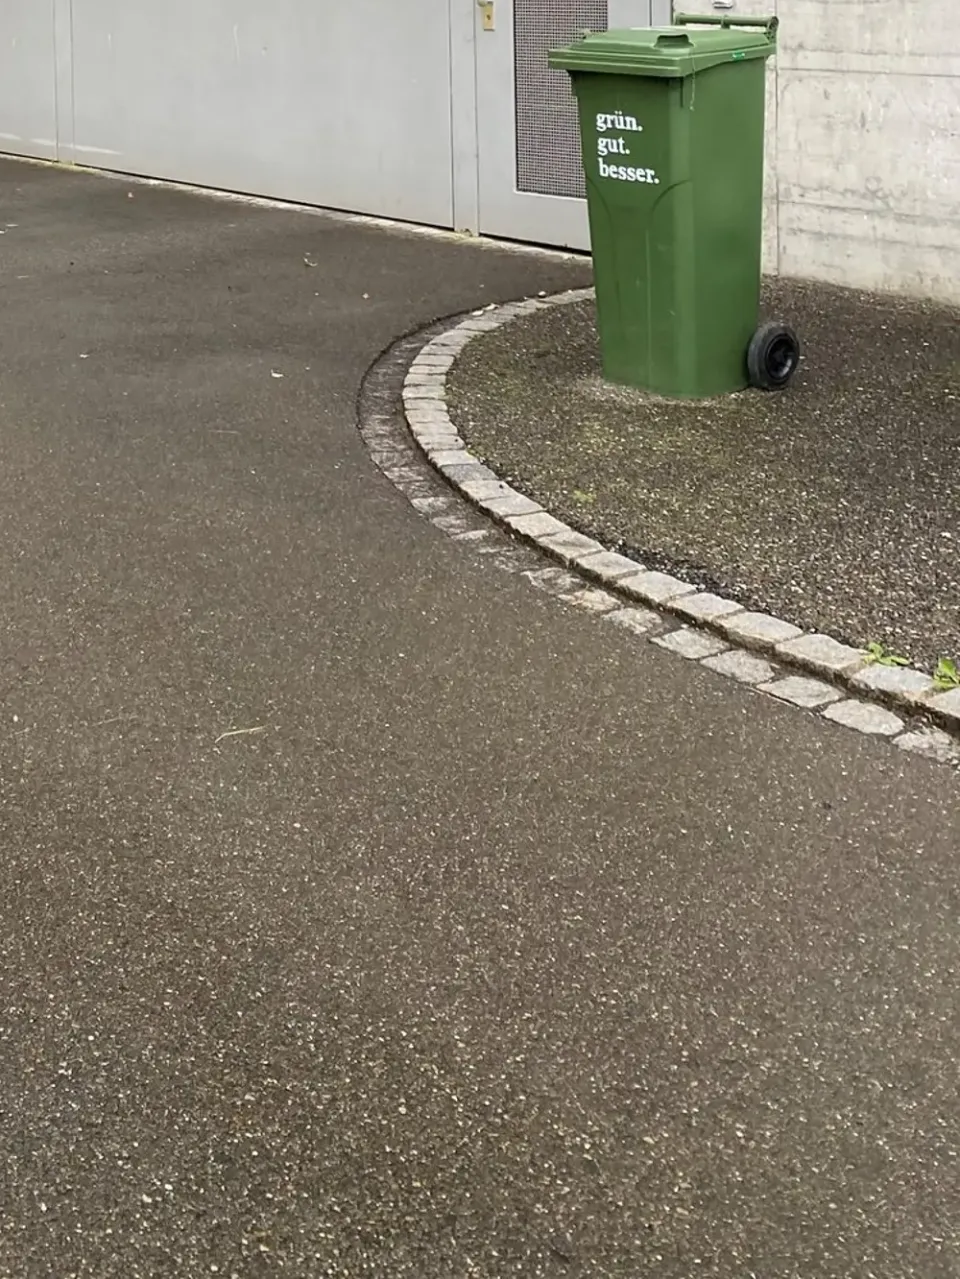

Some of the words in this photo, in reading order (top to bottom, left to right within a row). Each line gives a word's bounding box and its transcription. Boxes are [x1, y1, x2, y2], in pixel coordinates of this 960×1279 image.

[595, 110, 643, 132] grün.
[597, 136, 630, 156] gut.
[597, 157, 660, 184] besser.
